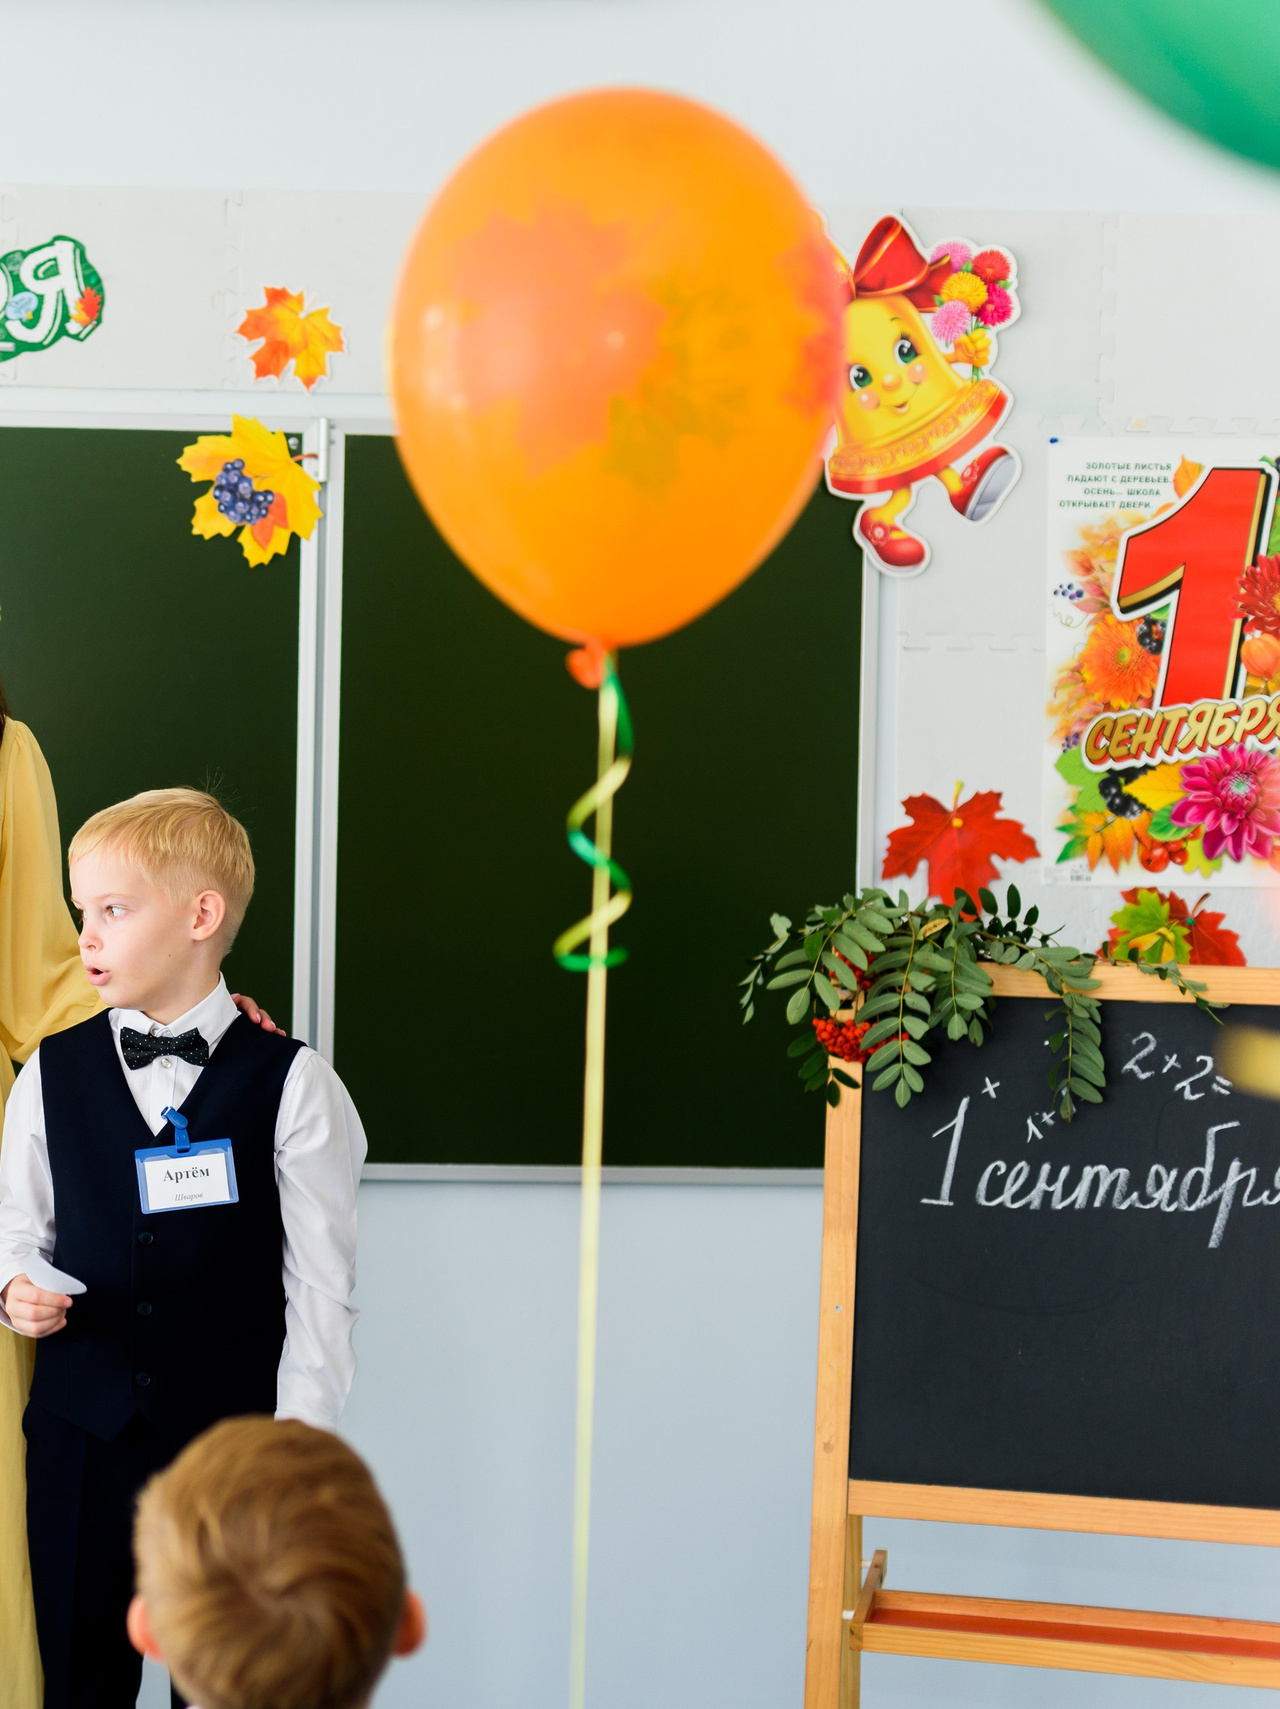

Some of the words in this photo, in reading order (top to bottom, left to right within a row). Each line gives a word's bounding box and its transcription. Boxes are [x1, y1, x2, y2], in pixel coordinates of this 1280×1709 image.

[1086, 462, 1132, 470] ЗОЛОТЫЕ
[1134, 463, 1172, 471] ЛИСТЬЯ
[1067, 474, 1109, 483] ПАДАЮТ
[1111, 475, 1118, 483] С
[1120, 475, 1172, 484] ДЕРЕВЬЕВ.
[1127, 488, 1161, 496] ШКОЛА
[1059, 500, 1117, 509] ОТКРЫВАЕТ
[1119, 500, 1154, 510] ДВЕРИ.
[1118, 466, 1270, 708] 1
[920, 1096, 970, 1206] 1
[163, 1166, 210, 1184] Артём
